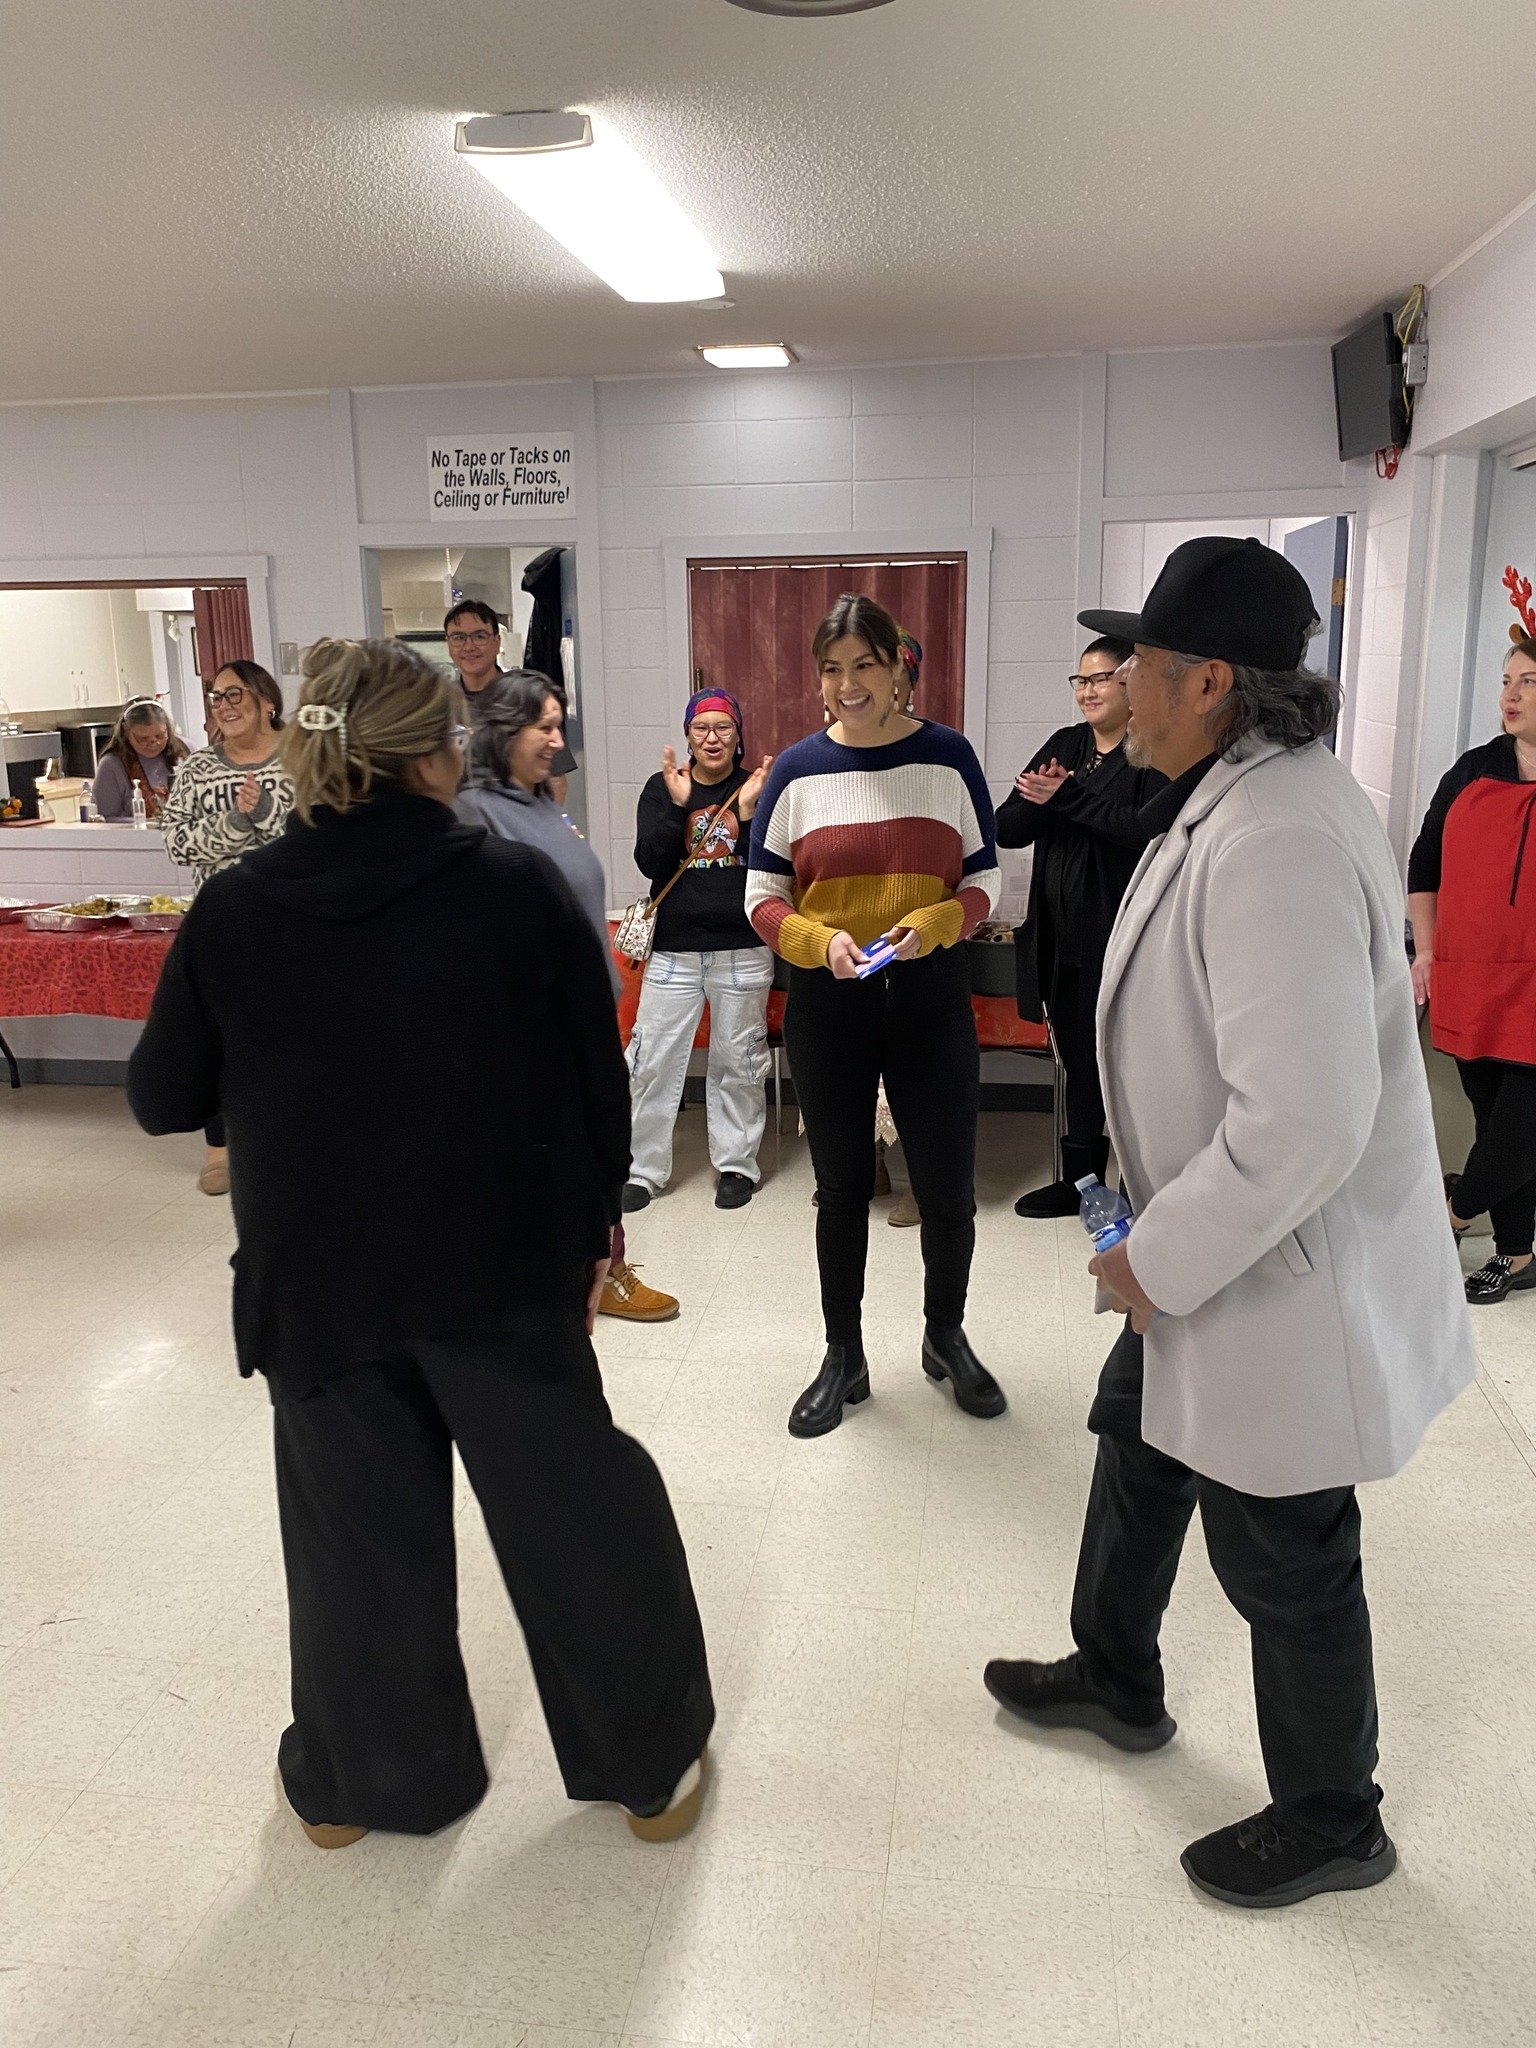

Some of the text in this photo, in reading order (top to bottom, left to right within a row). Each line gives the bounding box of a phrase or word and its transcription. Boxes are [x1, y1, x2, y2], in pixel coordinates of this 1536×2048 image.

[431, 446, 570, 468] No Tape or Tacks on
[444, 467, 561, 490] the Walls, Floors,
[434, 486, 570, 511] Ceiling or Furniture!
